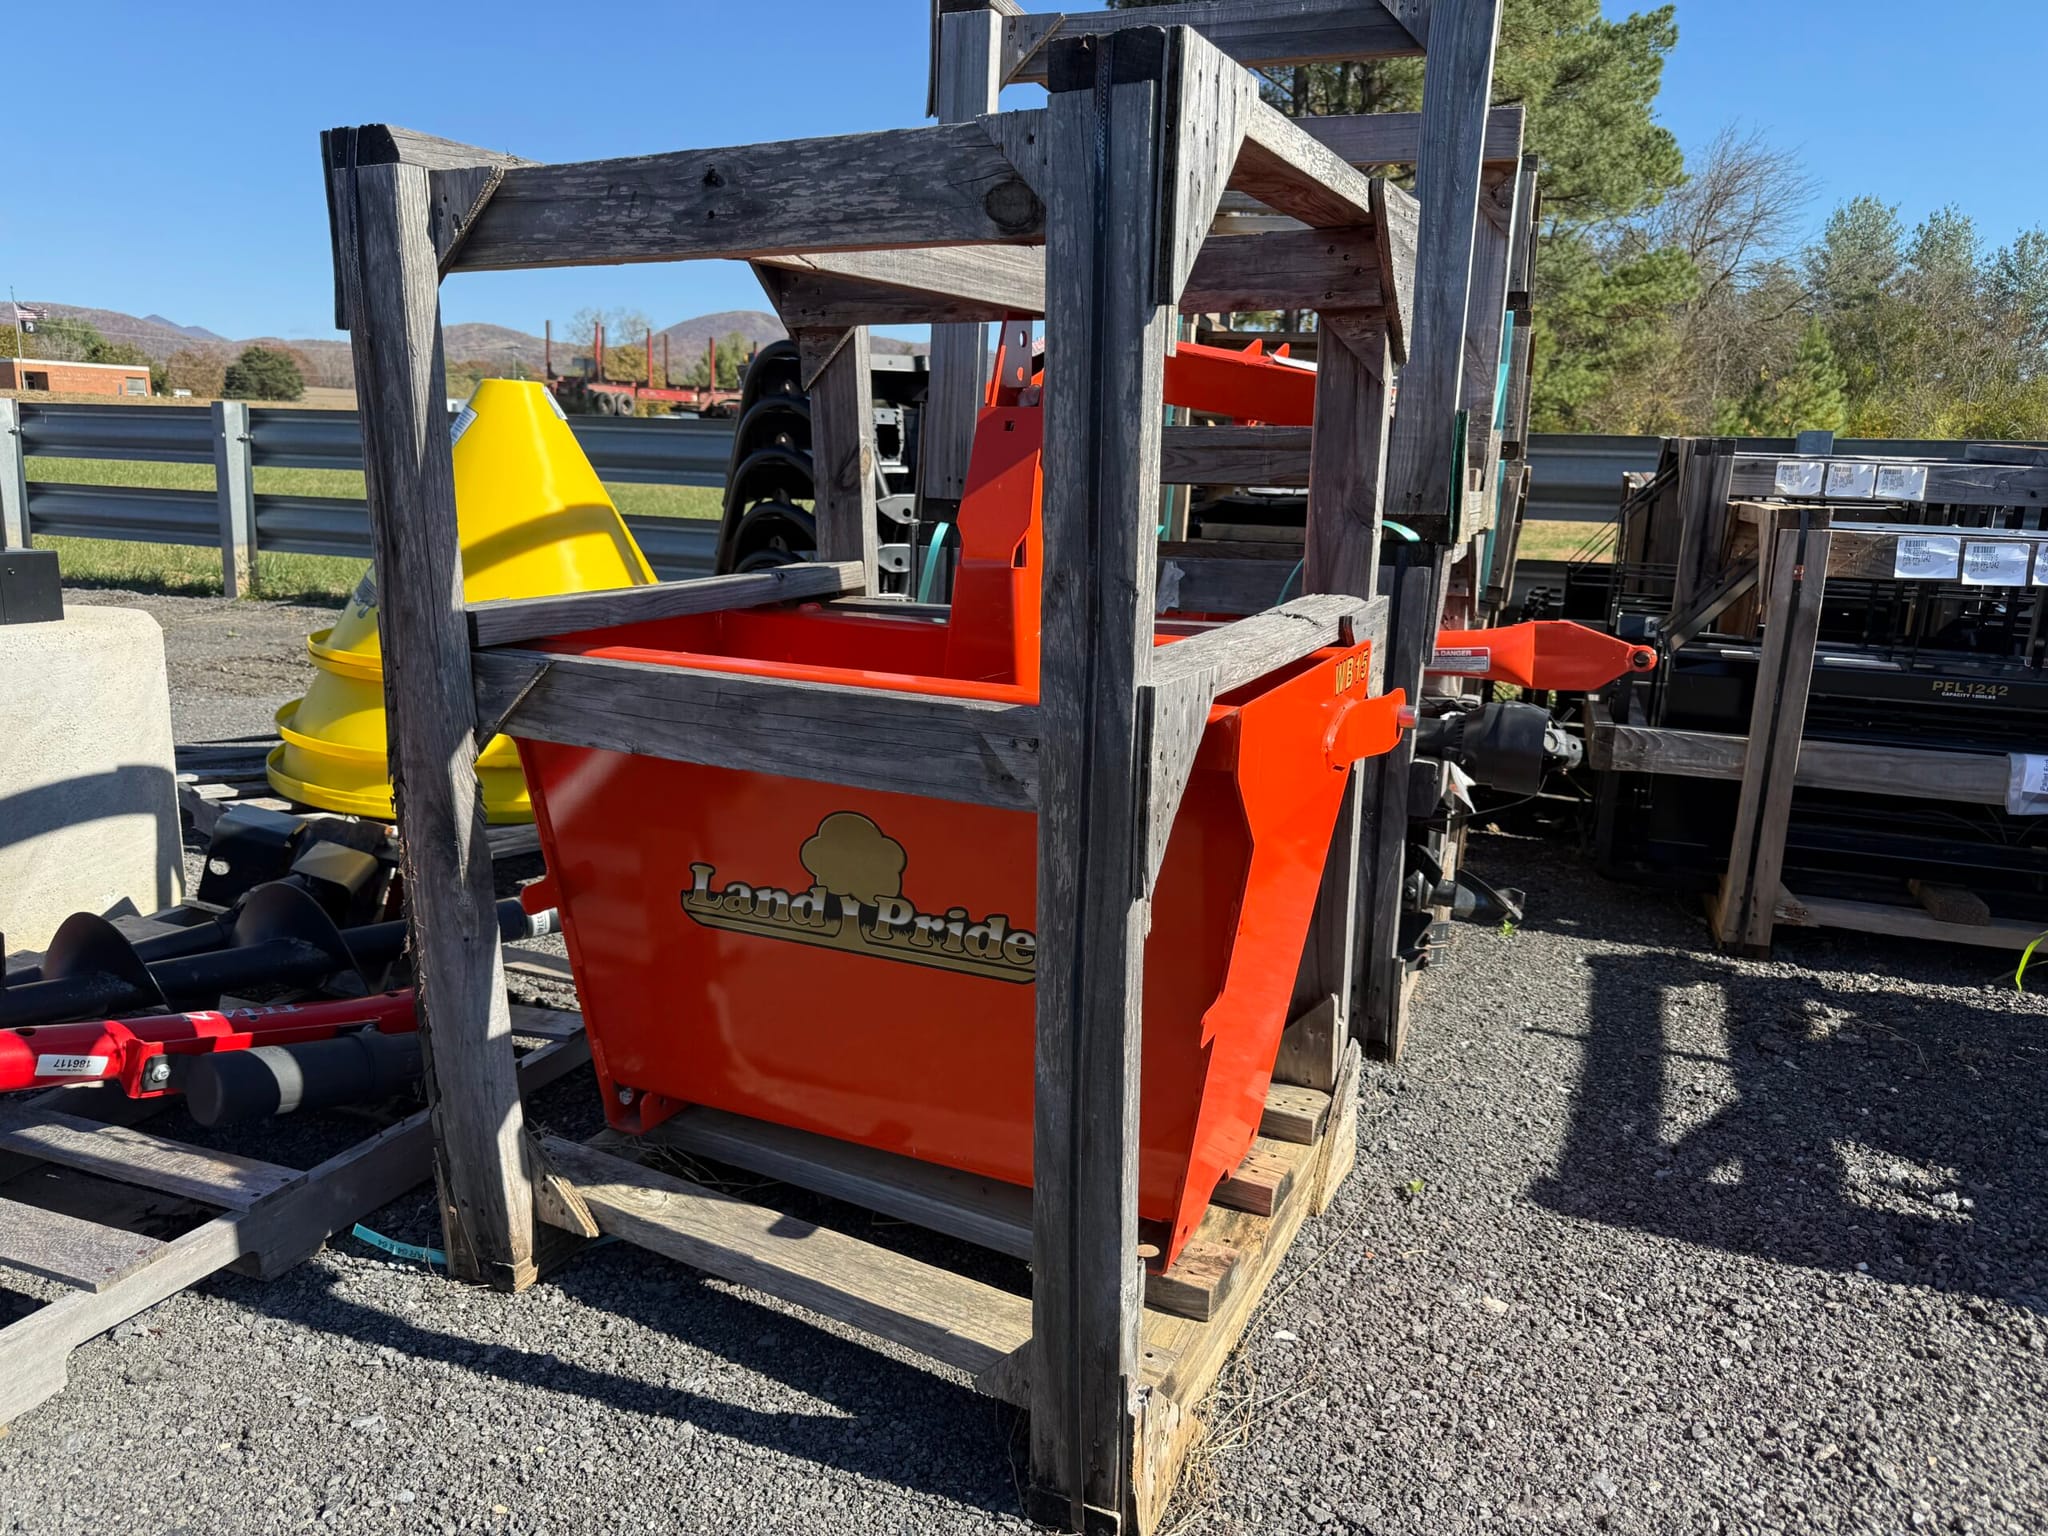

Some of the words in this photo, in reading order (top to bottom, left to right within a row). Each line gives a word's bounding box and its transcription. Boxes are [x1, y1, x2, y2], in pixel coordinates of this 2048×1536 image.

[1932, 681, 2009, 696] PFL1242
[688, 862, 830, 928] Land
[869, 893, 1036, 965] Pride
[54, 1059, 91, 1069] 186117
